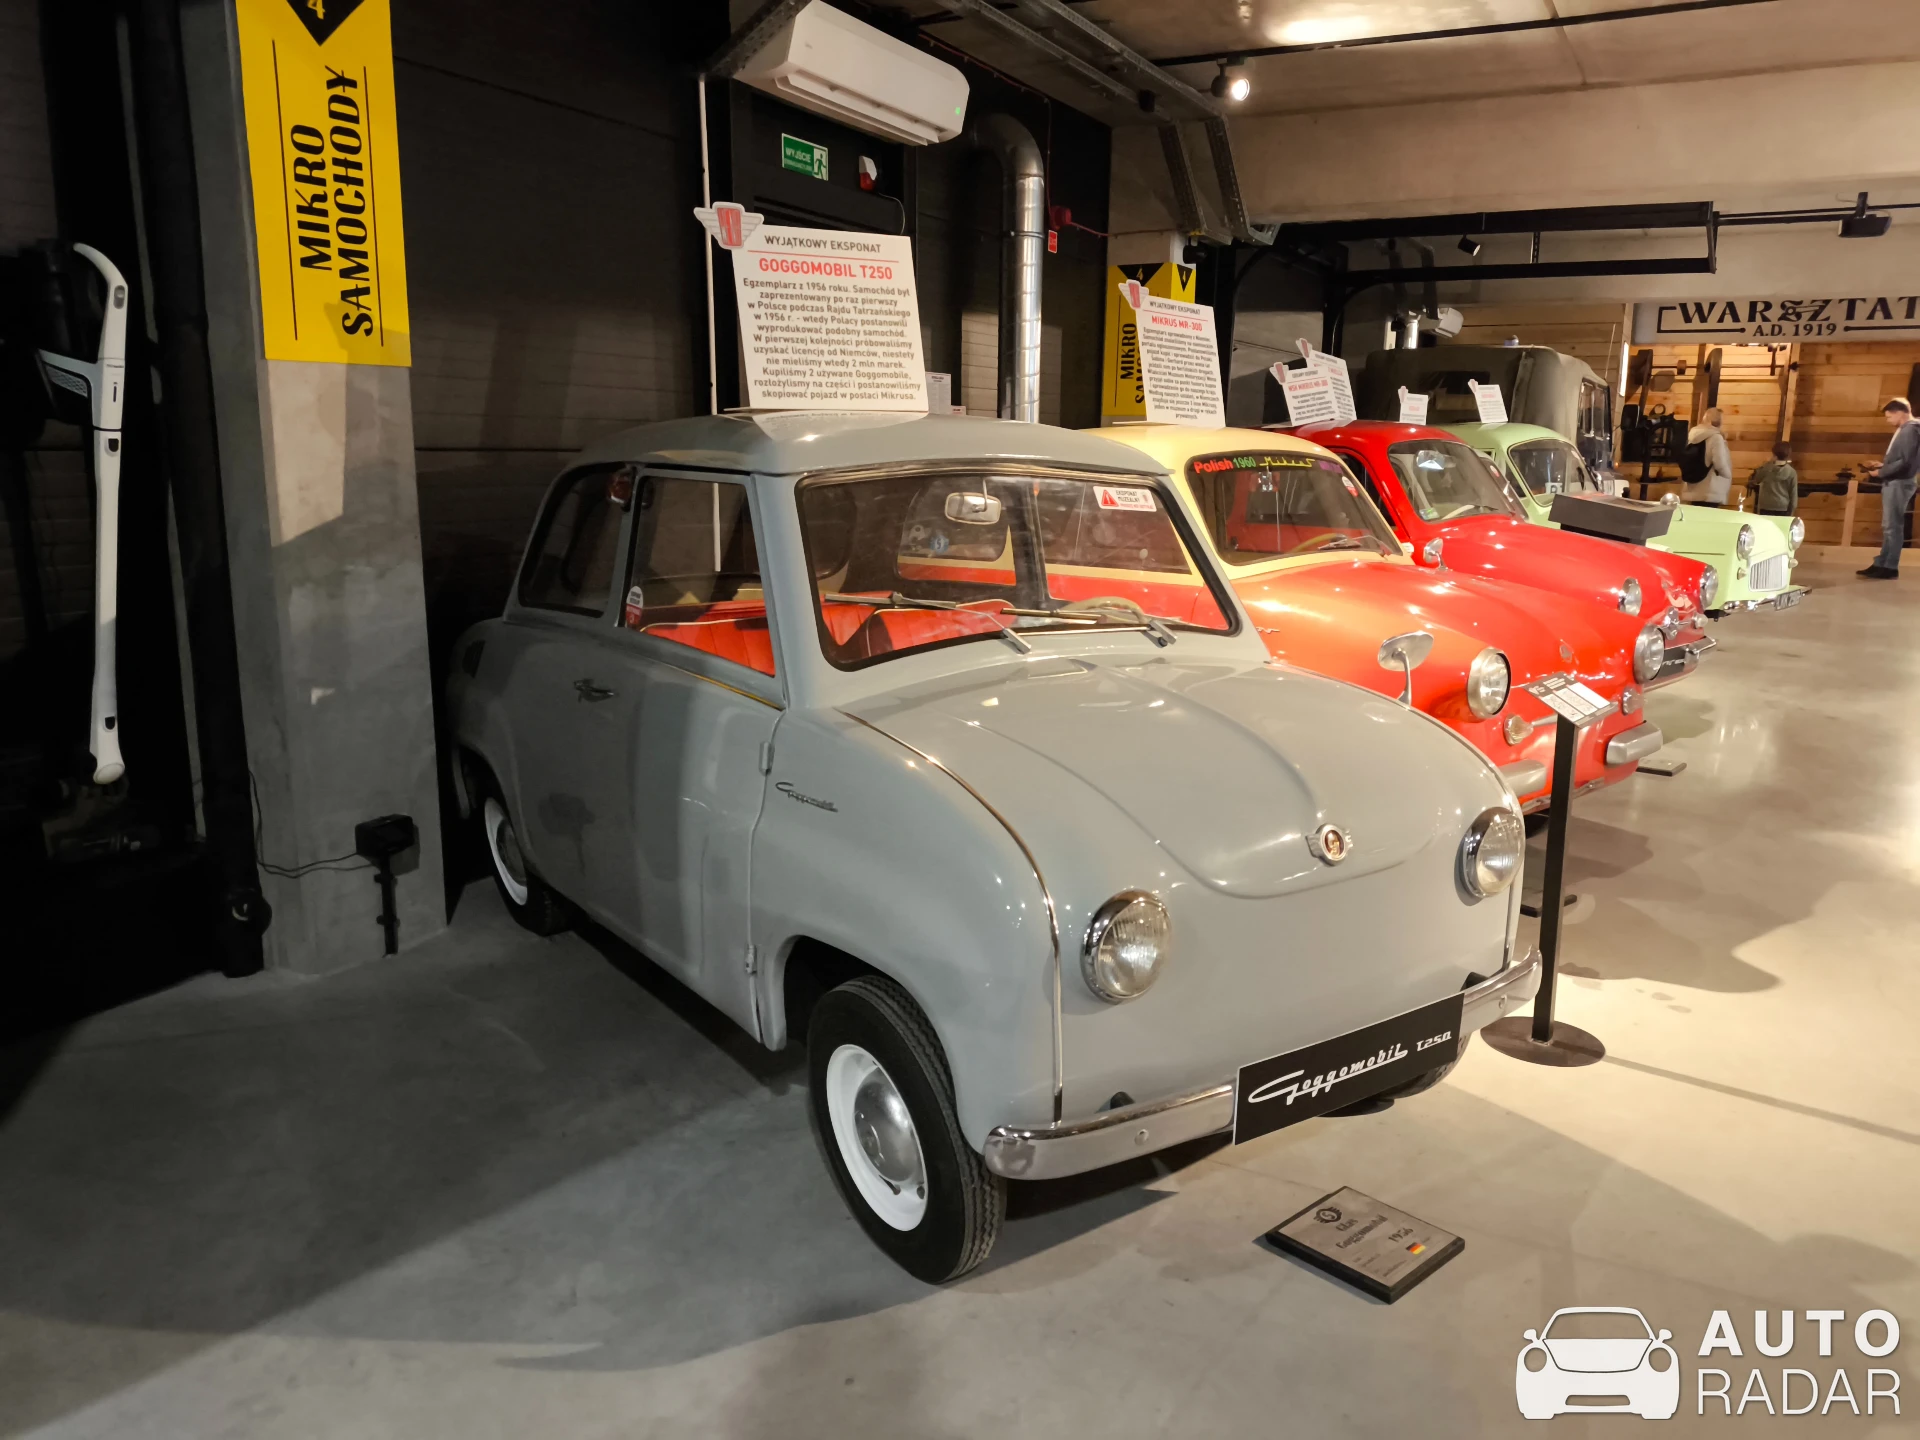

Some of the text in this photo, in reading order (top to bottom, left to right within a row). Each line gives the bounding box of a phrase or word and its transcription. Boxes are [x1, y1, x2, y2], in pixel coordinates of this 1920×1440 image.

[290, 124, 332, 271] MIKRO
[324, 65, 374, 337] SAMOCHODY
[764, 234, 881, 253] WYJĄTKOWY EKSPONAT
[758, 257, 893, 280] GOGGOMOBIL T250
[742, 277, 797, 290] Egzemplarz
[806, 281, 827, 292] 1956
[852, 284, 896, 296] Samochód
[759, 291, 898, 308] zaprezentowany po raz pierwszy
[757, 300, 788, 311] Polsce
[789, 303, 825, 313] podczas
[826, 303, 851, 315] Rajdu
[852, 305, 911, 319] Tatrzańskiego
[1678, 296, 1920, 324] WARSZTAT
[764, 311, 786, 322] 1956
[802, 315, 829, 325] wtedy
[830, 315, 859, 327] Polacy
[860, 318, 908, 328] postanowili
[1151, 315, 1203, 332] MIKRUS MR-300
[756, 324, 823, 335] wyprodukować
[825, 326, 861, 338] podobny
[1753, 323, 1836, 337] A.D. 1919
[752, 333, 763, 343] W
[764, 334, 808, 346] pierwszej
[809, 335, 853, 347] kolejności
[753, 345, 790, 355] uzyskać
[791, 346, 825, 357] licencję
[827, 348, 838, 356] od
[1120, 323, 1137, 380] MIKRO
[766, 357, 780, 365] nie
[782, 357, 822, 368] mieliśmy
[823, 359, 850, 369] wtedy
[851, 359, 857, 368] 2
[858, 359, 876, 368] mln
[762, 366, 807, 379] Kupiliśmy
[808, 368, 815, 377] 2
[816, 370, 854, 379] używane
[824, 380, 851, 390] części
[857, 381, 921, 391] postanowiliśmy
[761, 389, 808, 400] skopiować
[810, 390, 838, 401] pojazd
[849, 391, 879, 401] postaci
[1193, 458, 1234, 474] Polish
[1233, 456, 1256, 469] 1960
[1248, 1030, 1452, 1105] Goggomobil T250
[1388, 1227, 1414, 1243] 1956
